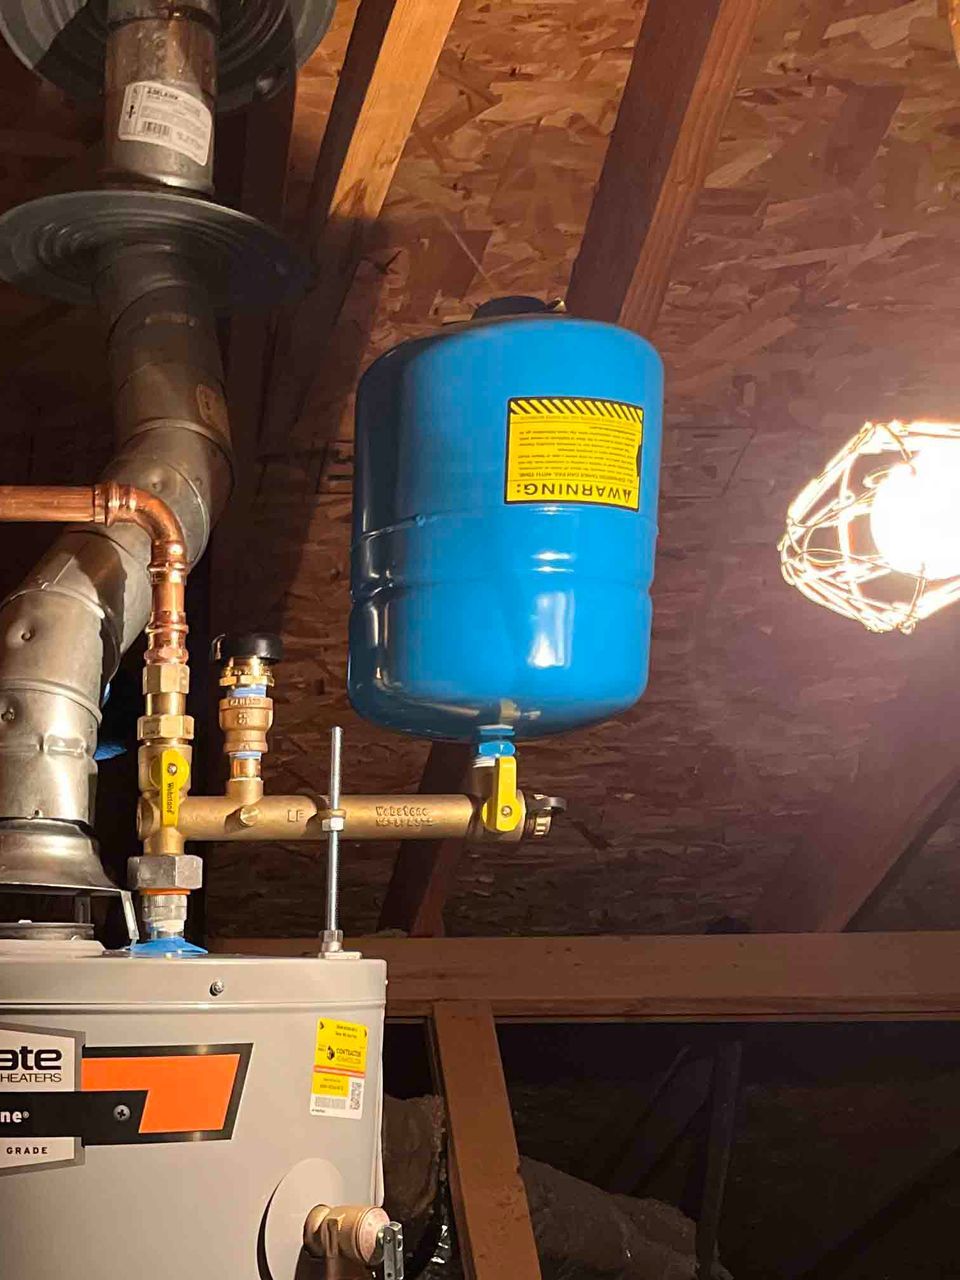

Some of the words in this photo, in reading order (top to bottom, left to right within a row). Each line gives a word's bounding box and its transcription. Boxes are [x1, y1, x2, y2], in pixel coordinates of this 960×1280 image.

[516, 483, 621, 500] WARNING:
[287, 809, 304, 822] LF
[0, 1072, 62, 1083] HEATERS
[6, 1146, 48, 1154] GRADE
